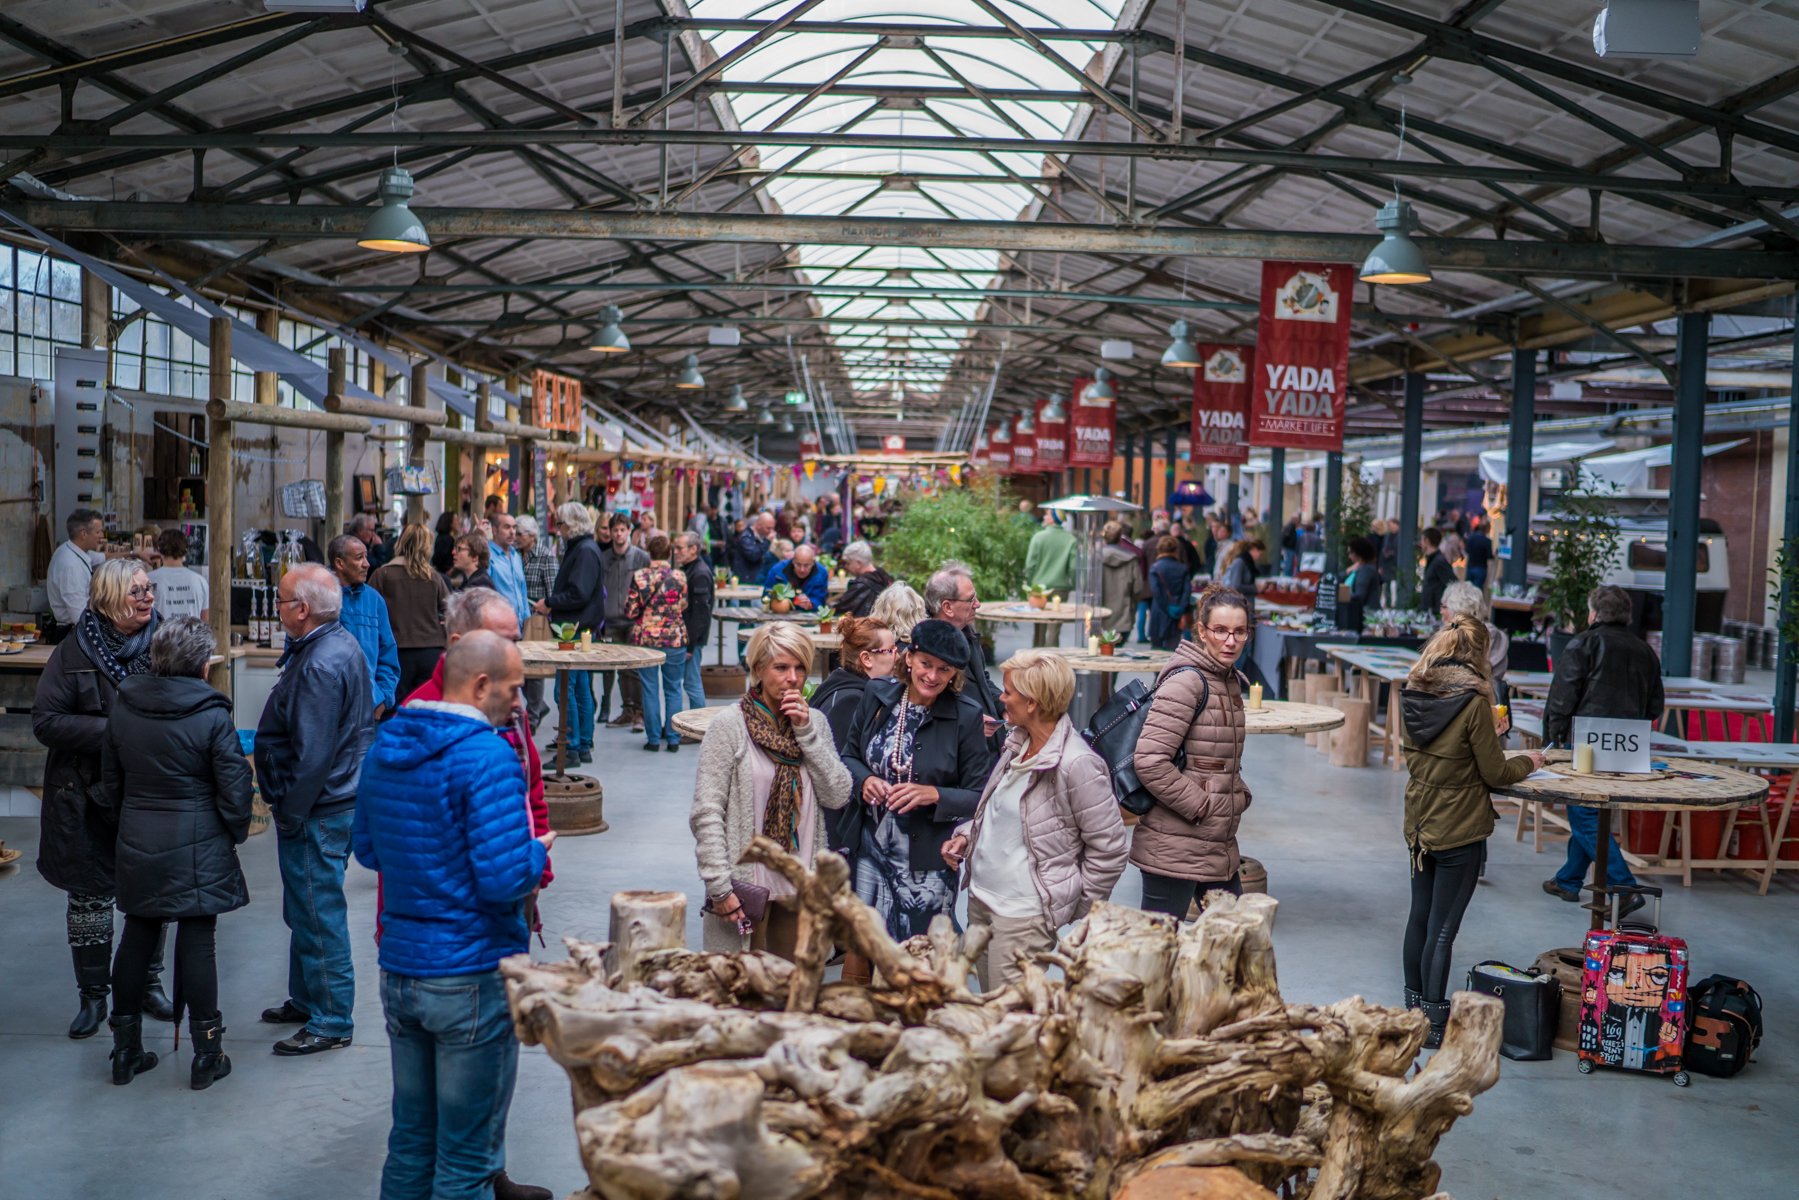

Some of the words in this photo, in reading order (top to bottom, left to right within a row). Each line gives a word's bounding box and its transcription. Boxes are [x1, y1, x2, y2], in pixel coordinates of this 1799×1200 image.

[1265, 363, 1336, 394] YADA
[1264, 389, 1334, 418] YADA
[1198, 410, 1245, 429] YADA
[1265, 420, 1309, 432] MARKET
[1311, 423, 1329, 434] LIFE
[1075, 426, 1111, 442] YADA
[1198, 427, 1244, 445] YADA
[1587, 732, 1639, 753] PERS
